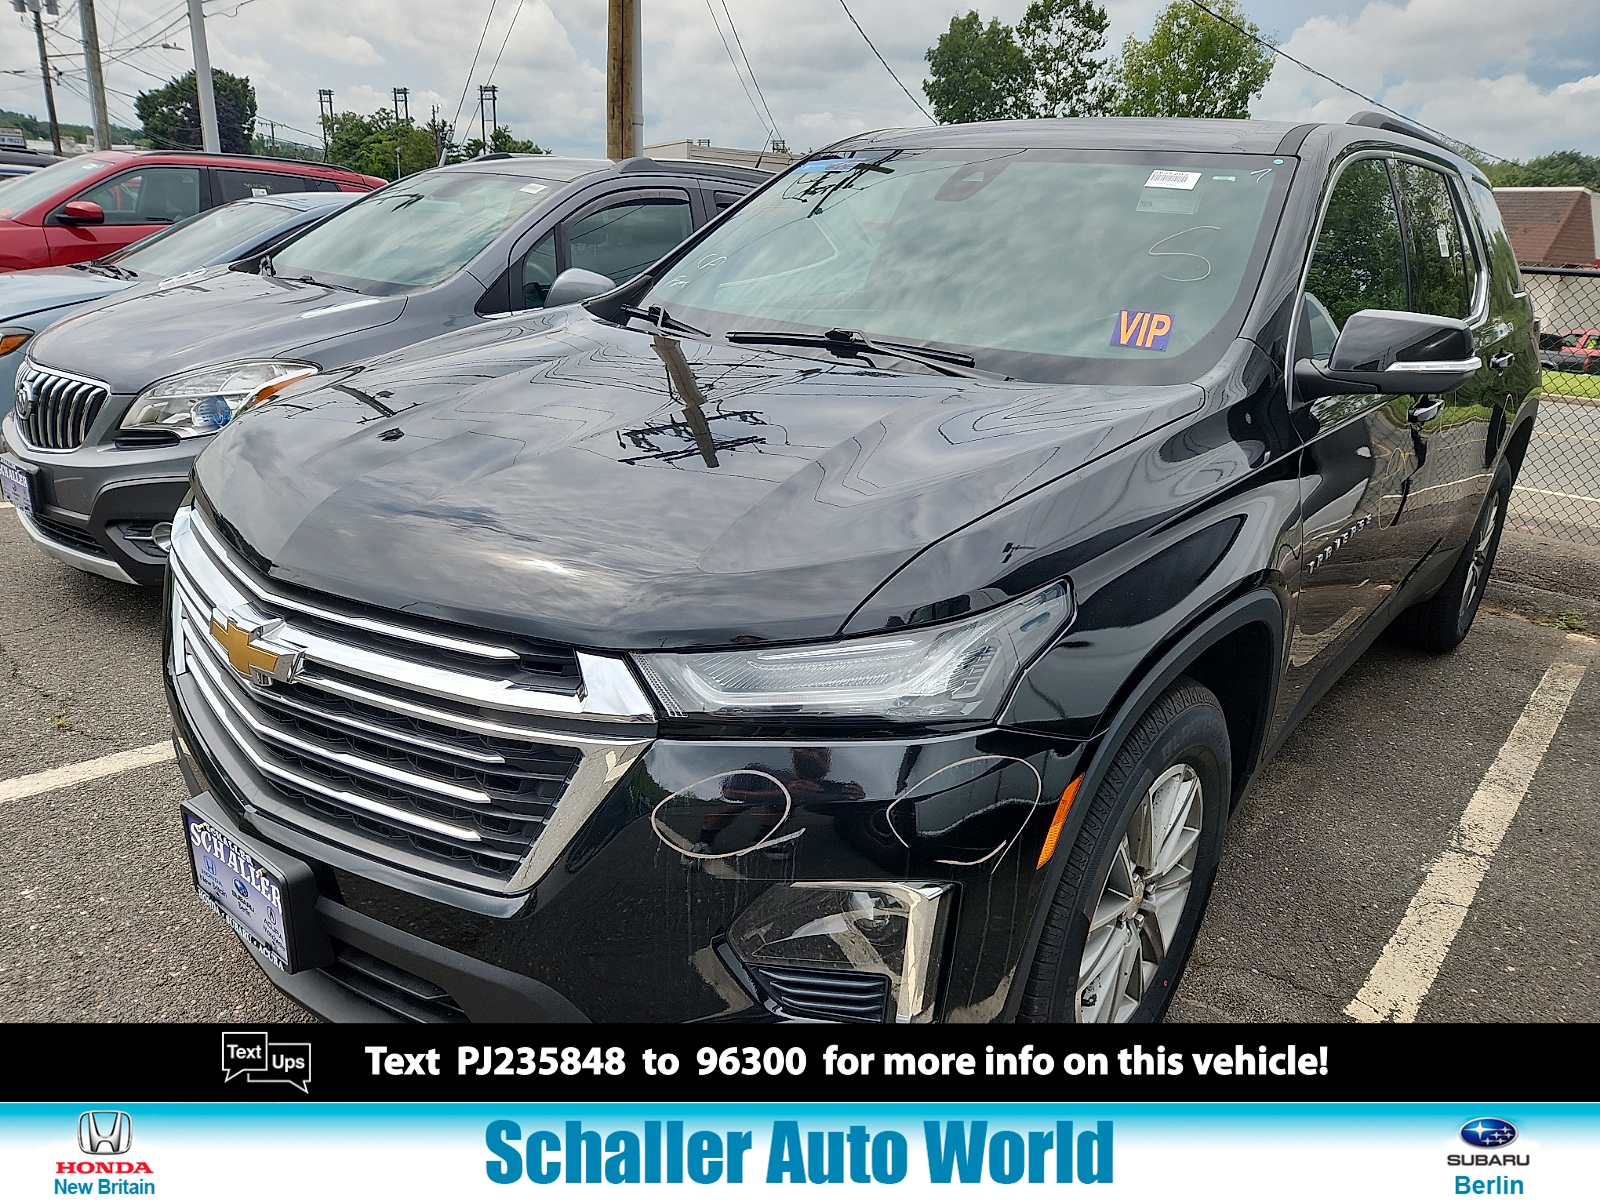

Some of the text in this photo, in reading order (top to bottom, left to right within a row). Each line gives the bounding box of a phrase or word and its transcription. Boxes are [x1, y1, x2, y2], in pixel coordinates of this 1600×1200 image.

[1119, 310, 1173, 348] VIP
[1307, 513, 1372, 575] TRAVERSE
[190, 822, 282, 915] SCHALLER
[258, 943, 285, 972] ACURA
